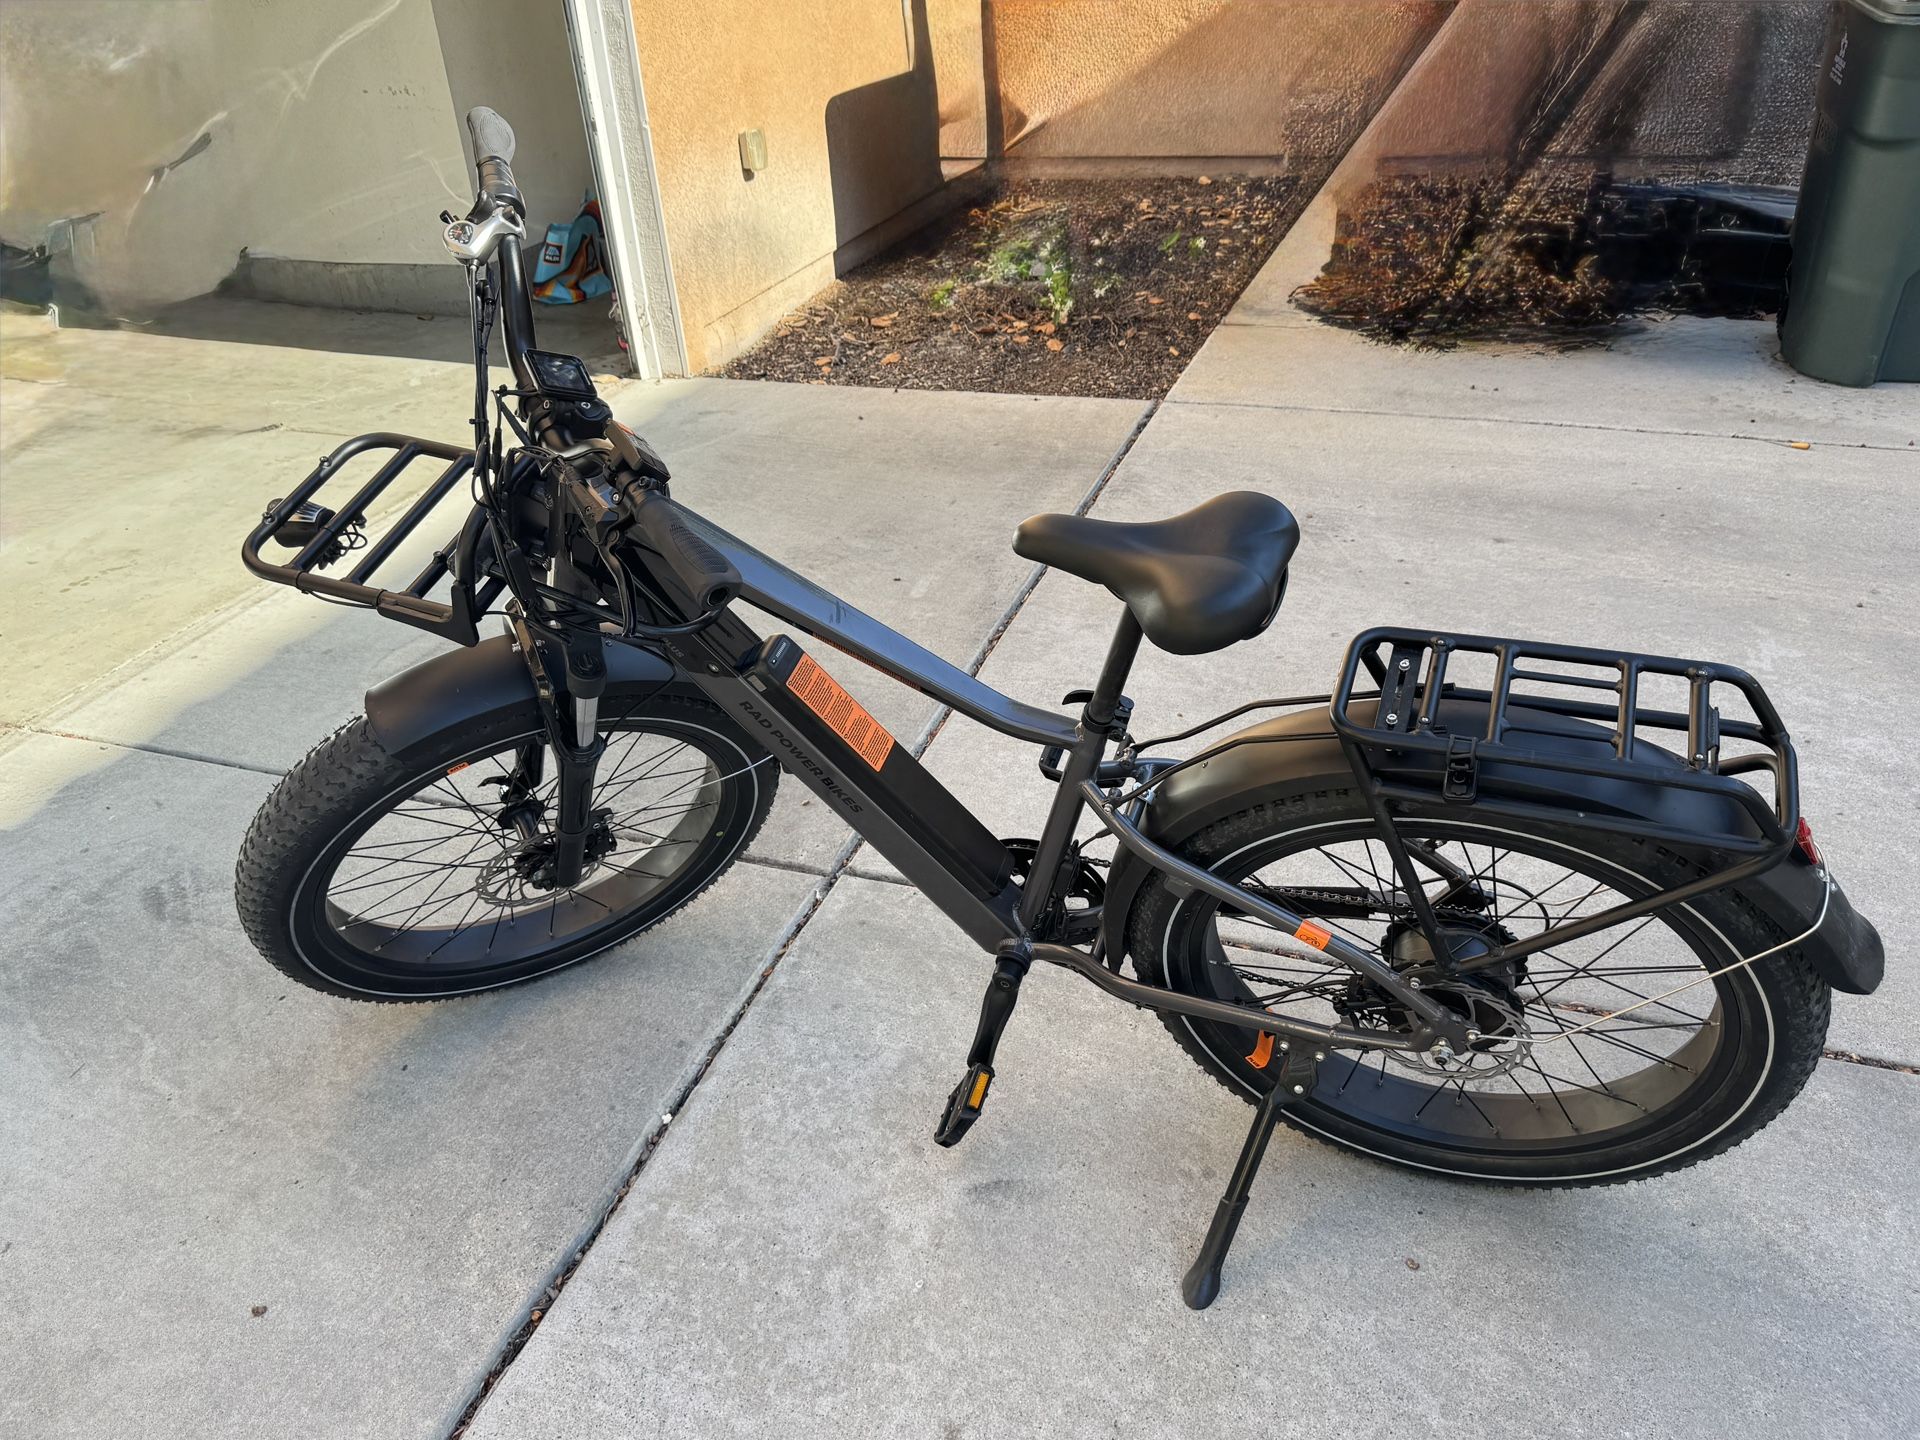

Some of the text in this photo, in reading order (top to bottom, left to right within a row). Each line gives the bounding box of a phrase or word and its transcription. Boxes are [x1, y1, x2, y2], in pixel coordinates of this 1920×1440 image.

[739, 700, 864, 814] RAD POWER BIKES
